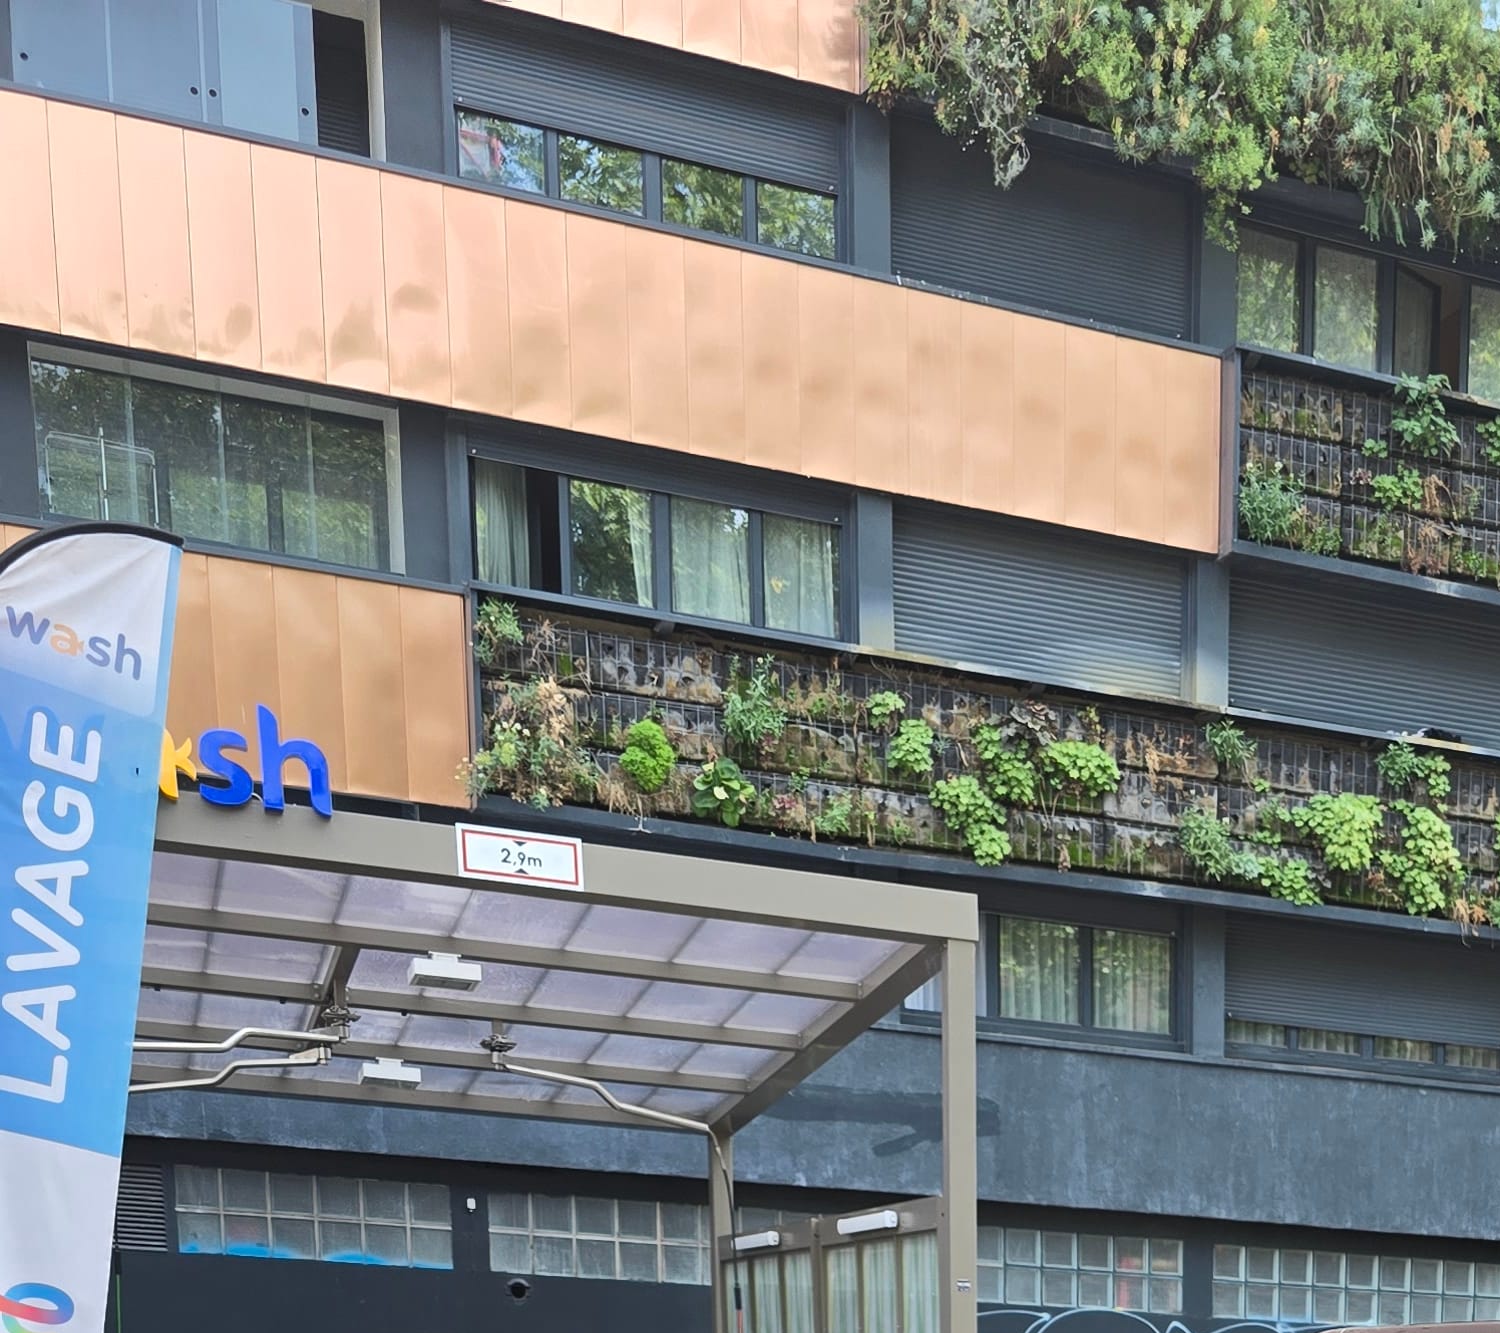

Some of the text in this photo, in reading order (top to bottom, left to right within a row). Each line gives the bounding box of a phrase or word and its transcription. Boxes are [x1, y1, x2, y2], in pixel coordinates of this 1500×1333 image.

[6, 605, 142, 681] wash
[500, 847, 543, 867] 2,9m
[0, 711, 102, 1103] LAVAGE
